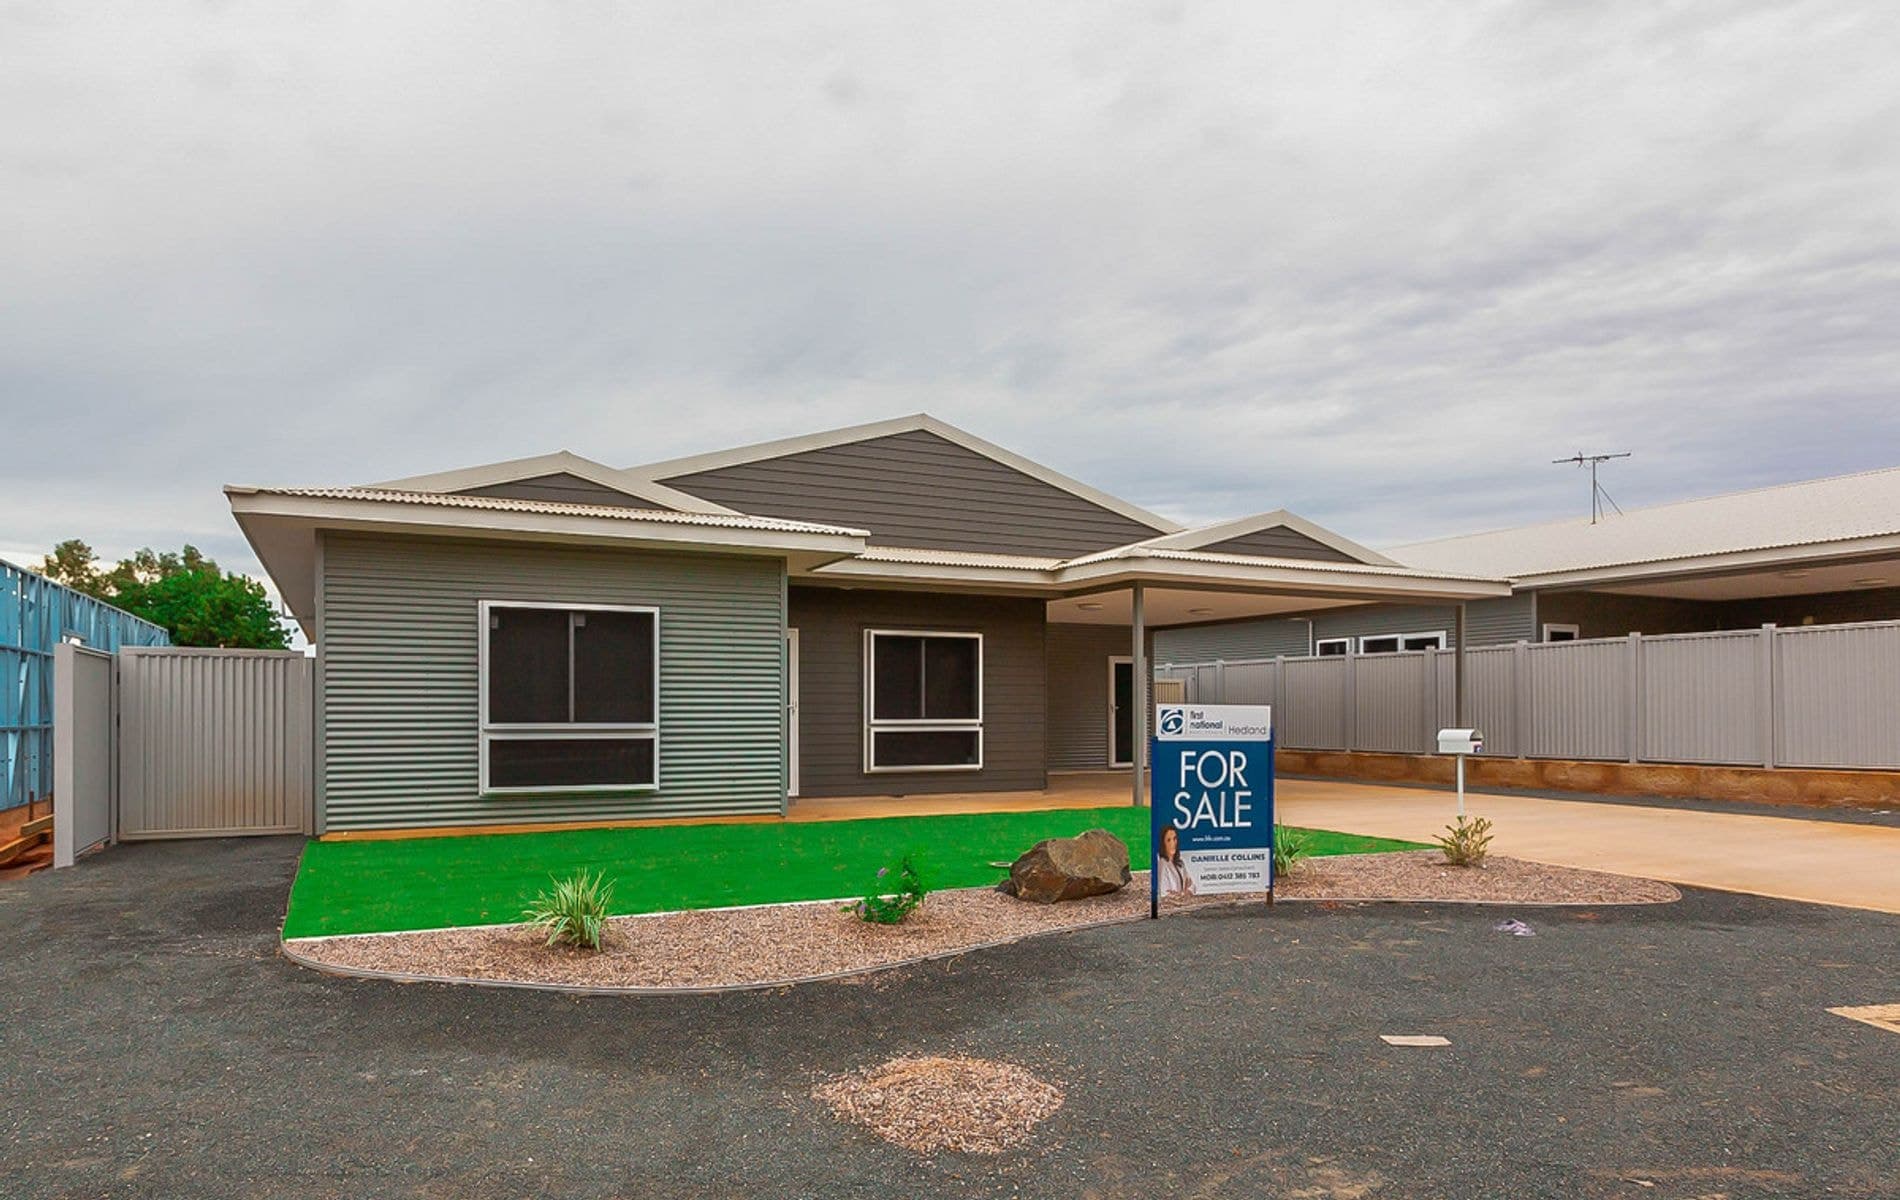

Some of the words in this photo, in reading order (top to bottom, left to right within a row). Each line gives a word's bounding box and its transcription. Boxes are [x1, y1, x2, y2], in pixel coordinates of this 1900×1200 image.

[1190, 711, 1204, 719] first
[1190, 720, 1223, 729] national
[1228, 725, 1266, 735] Hedland
[1181, 750, 1248, 788] FOR
[1173, 791, 1252, 829] SALE
[1191, 855, 1229, 863] DANIELLE
[1231, 853, 1265, 861] COLLINS
